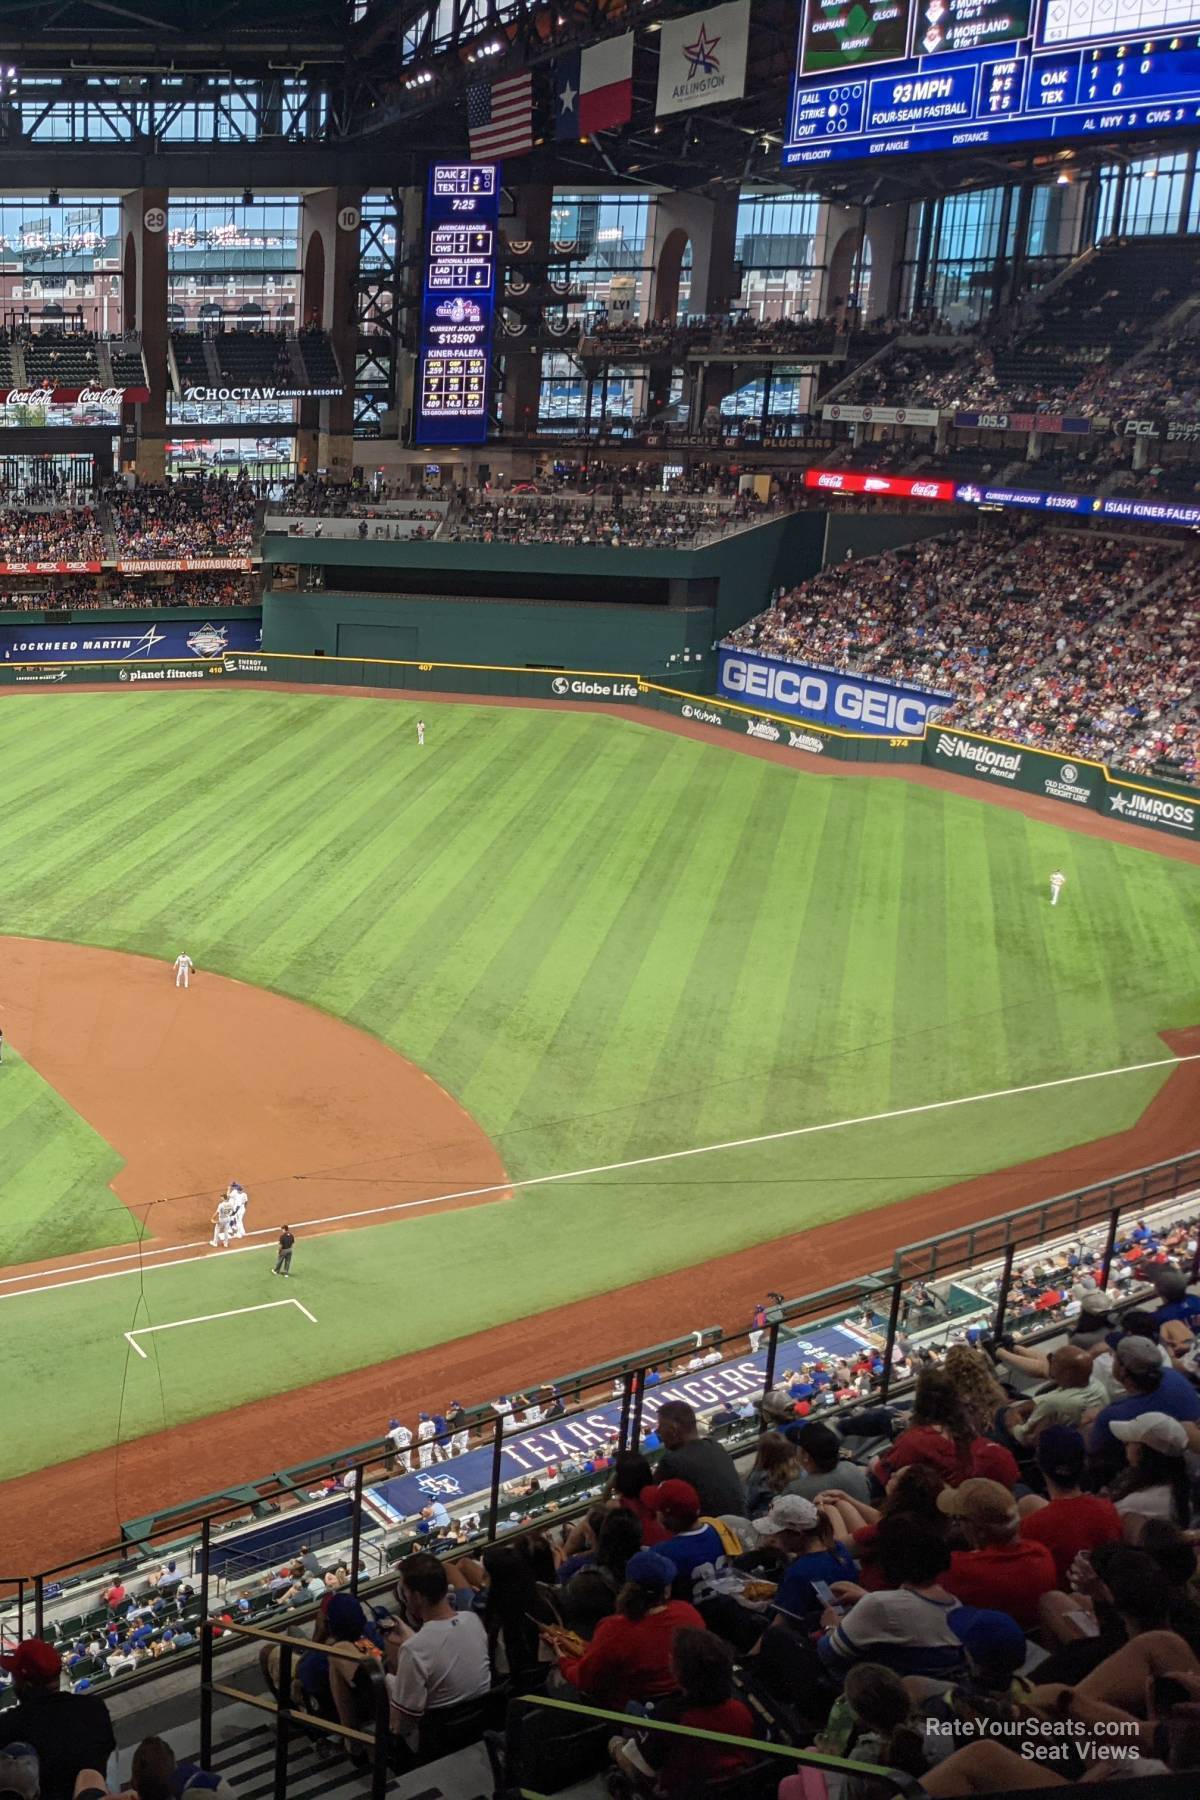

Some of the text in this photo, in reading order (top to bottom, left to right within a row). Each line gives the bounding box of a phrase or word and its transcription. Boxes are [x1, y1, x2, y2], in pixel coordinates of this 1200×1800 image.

[872, 8, 898, 22] OLSON
[812, 19, 846, 33] CHAPMAN
[841, 37, 870, 50] MURPHY
[993, 62, 1015, 75] MVR
[1041, 71, 1068, 87] OAK
[672, 75, 725, 99] ARLINGTON
[892, 78, 952, 103] 93 MPH
[801, 92, 820, 105] BALL
[1040, 91, 1064, 105] TEX
[800, 106, 826, 120] STRIKE
[871, 102, 967, 125] FOUR-SEAM FASTBALL
[1083, 109, 1184, 129] AL NYY 3 CWS 3
[798, 124, 815, 136] OUT
[952, 131, 988, 144] DISTANCE
[870, 140, 909, 153] EXIT ANGLE
[787, 149, 831, 163] EXIT VELOCITY
[437, 170, 456, 179] OAK
[437, 183, 455, 192] TEX
[452, 199, 475, 210] 7:25
[146, 213, 164, 227] 29
[342, 212, 355, 226] 10
[436, 234, 452, 242] NYY
[435, 245, 451, 253] CWS
[438, 334, 475, 344] $13590
[428, 349, 483, 358] KINER-FALEFA
[6, 388, 54, 405] Coca-Cola
[78, 388, 125, 405] Coca-Cola
[194, 387, 274, 401] CHOCTAW
[977, 414, 1008, 429] 105.3
[1124, 420, 1160, 437] PGL
[762, 438, 831, 448] PLUCKERS
[985, 491, 1077, 509] CURRENT JACKPOT $13590
[1092, 500, 1100, 511] 9
[1104, 502, 1131, 515] ISIAH
[36, 562, 58, 570] DEX
[121, 561, 181, 572] WHATABURGER
[186, 559, 248, 570] WHATABURGER
[13, 640, 131, 651] LOCKHEED MARTIN
[129, 668, 204, 681] planet fitness
[571, 680, 638, 697] Globe Life
[722, 658, 829, 711] GEICO
[693, 707, 722, 725] Kubota
[889, 739, 908, 747] 374
[955, 739, 1021, 771] National
[975, 763, 1016, 780] Car Rental
[1044, 779, 1091, 797] OLD DOMINION
[1045, 786, 1088, 803] FREIGHT LINE
[1124, 807, 1158, 822] LAW GROUP
[500, 1362, 769, 1470] TEXAS ANGERS
